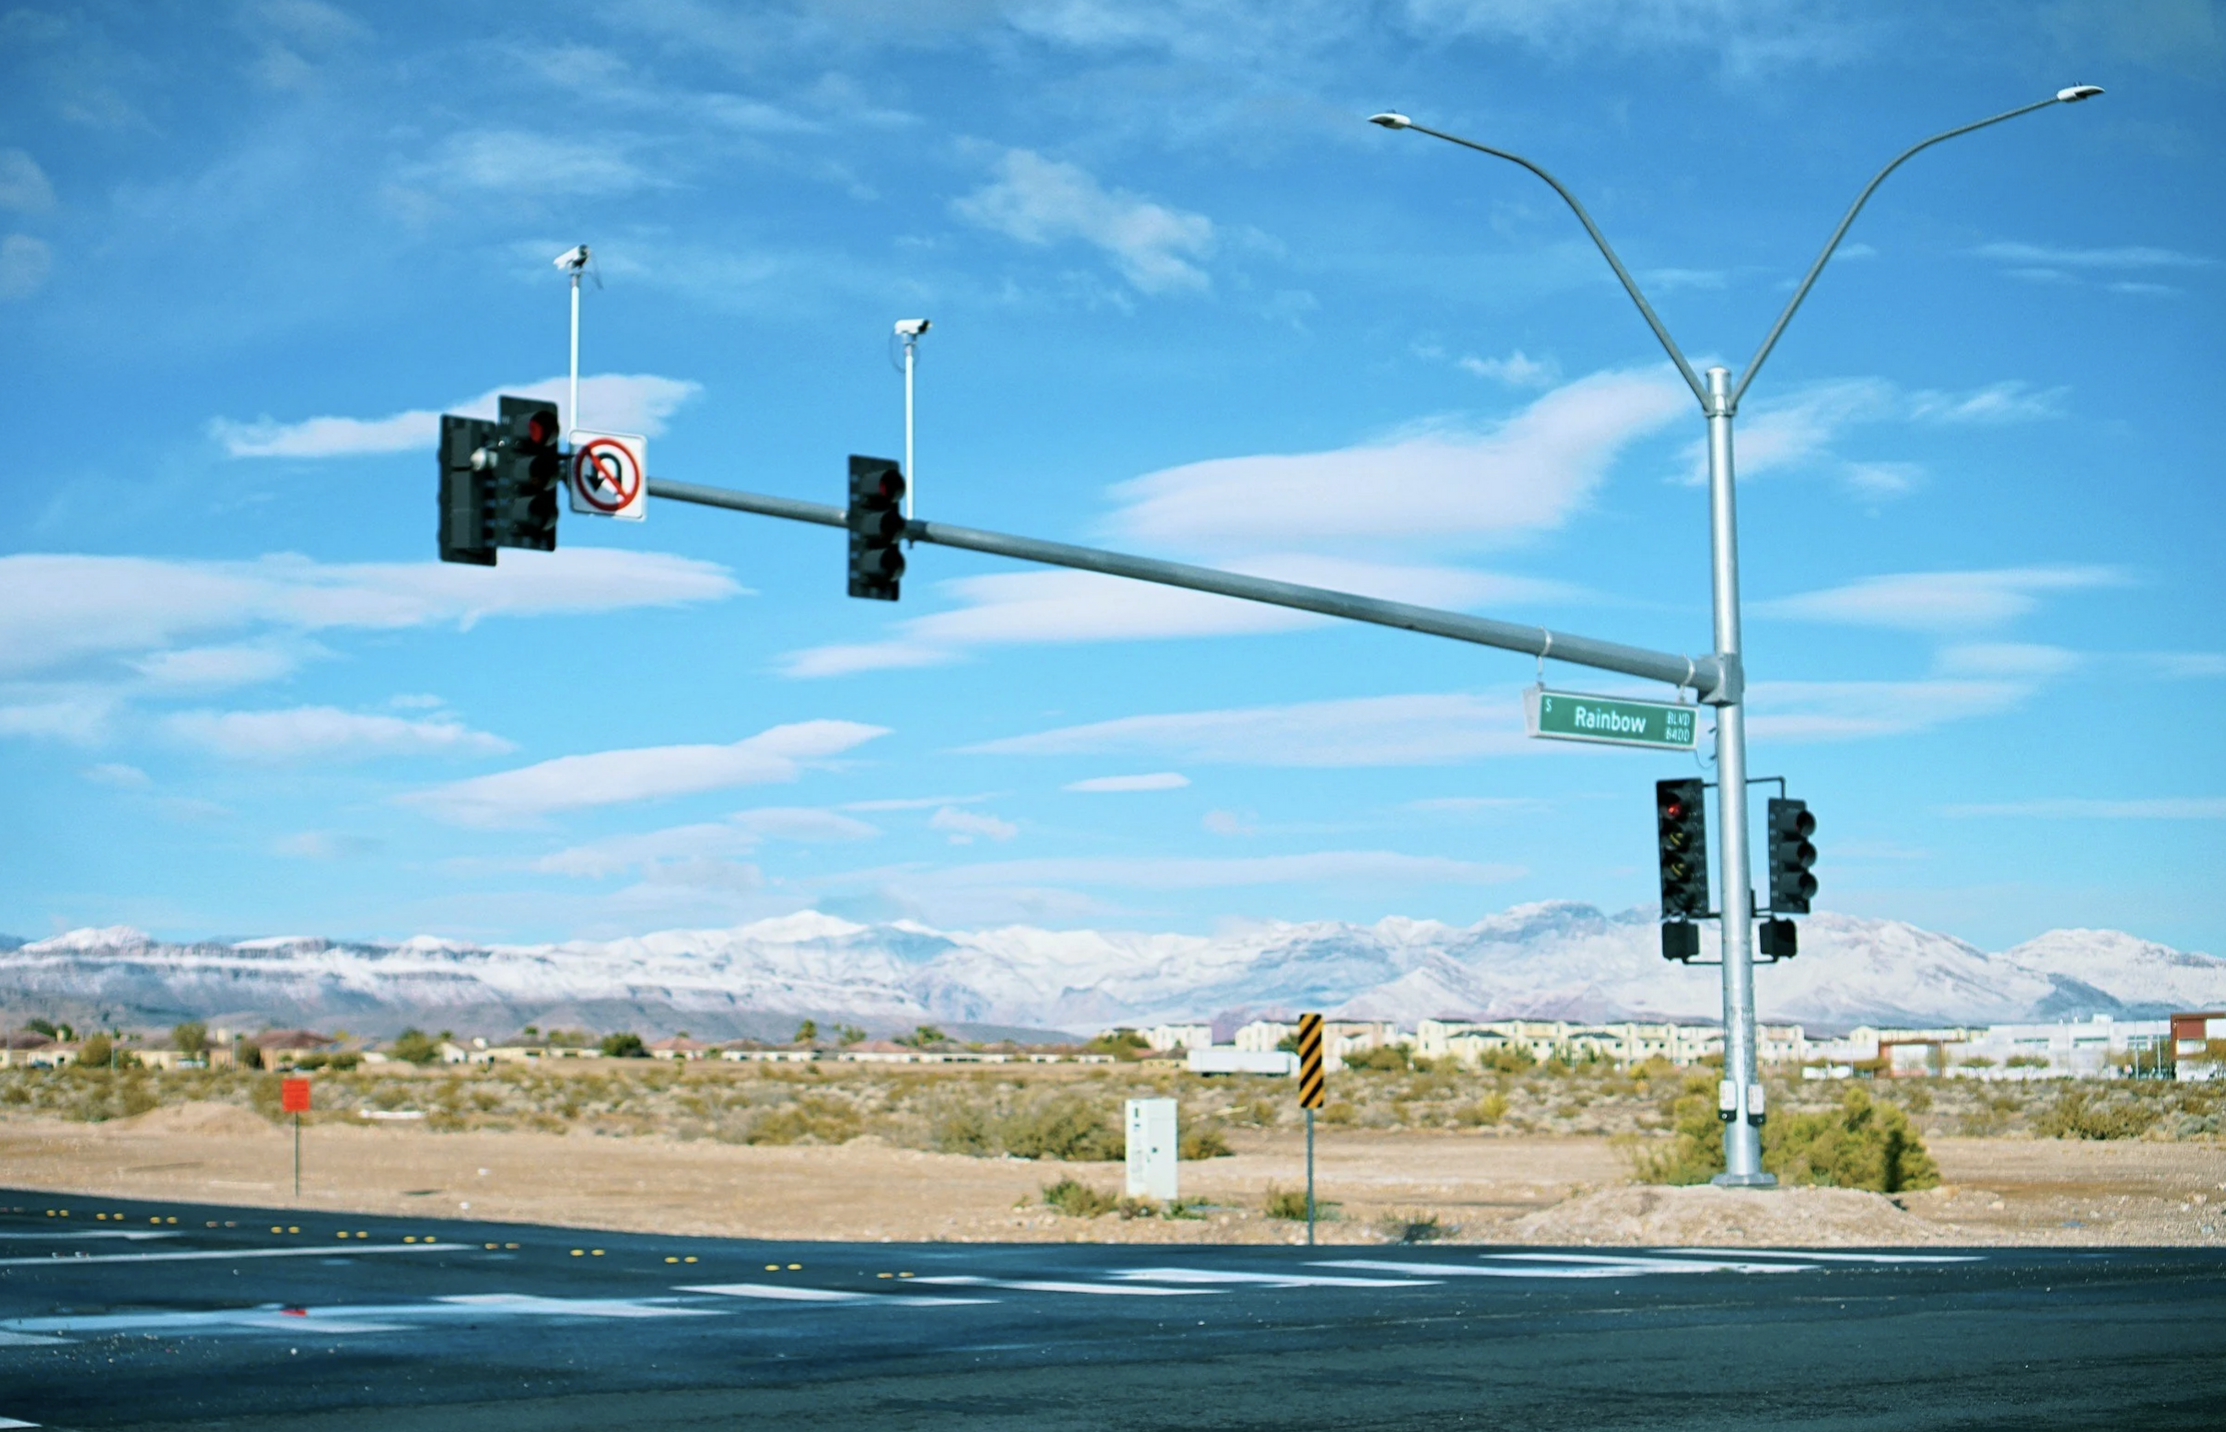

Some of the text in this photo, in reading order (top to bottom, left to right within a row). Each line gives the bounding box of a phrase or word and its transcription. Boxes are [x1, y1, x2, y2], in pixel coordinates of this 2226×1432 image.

[1545, 698, 1690, 733] S Rainbow BLVD
